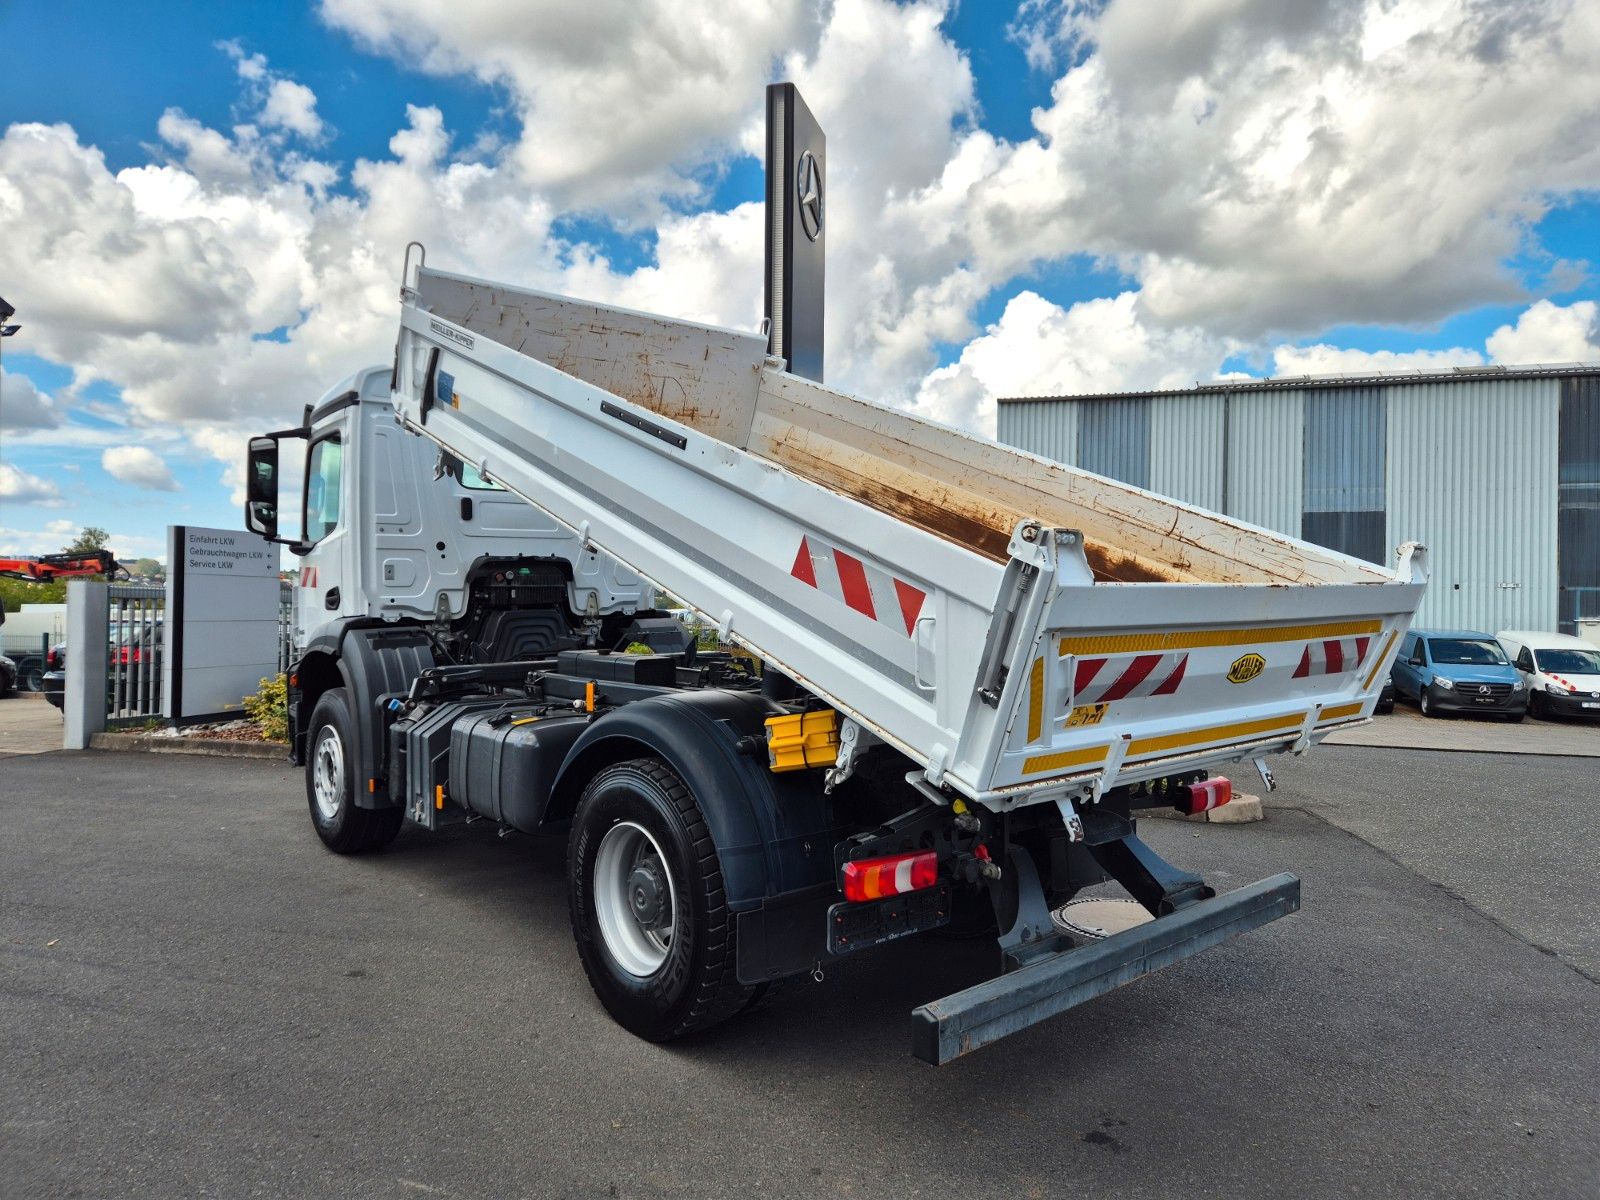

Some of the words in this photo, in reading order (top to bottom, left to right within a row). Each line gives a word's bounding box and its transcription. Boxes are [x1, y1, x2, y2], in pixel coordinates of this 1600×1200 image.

[189, 534, 218, 544] Einfahrt
[219, 537, 235, 545] LKW
[189, 547, 247, 559] Gebrauchtwagen
[248, 551, 263, 559] LKW
[189, 560, 216, 568] Service
[217, 561, 233, 569] LKW
[1231, 657, 1263, 680] MEILLER
